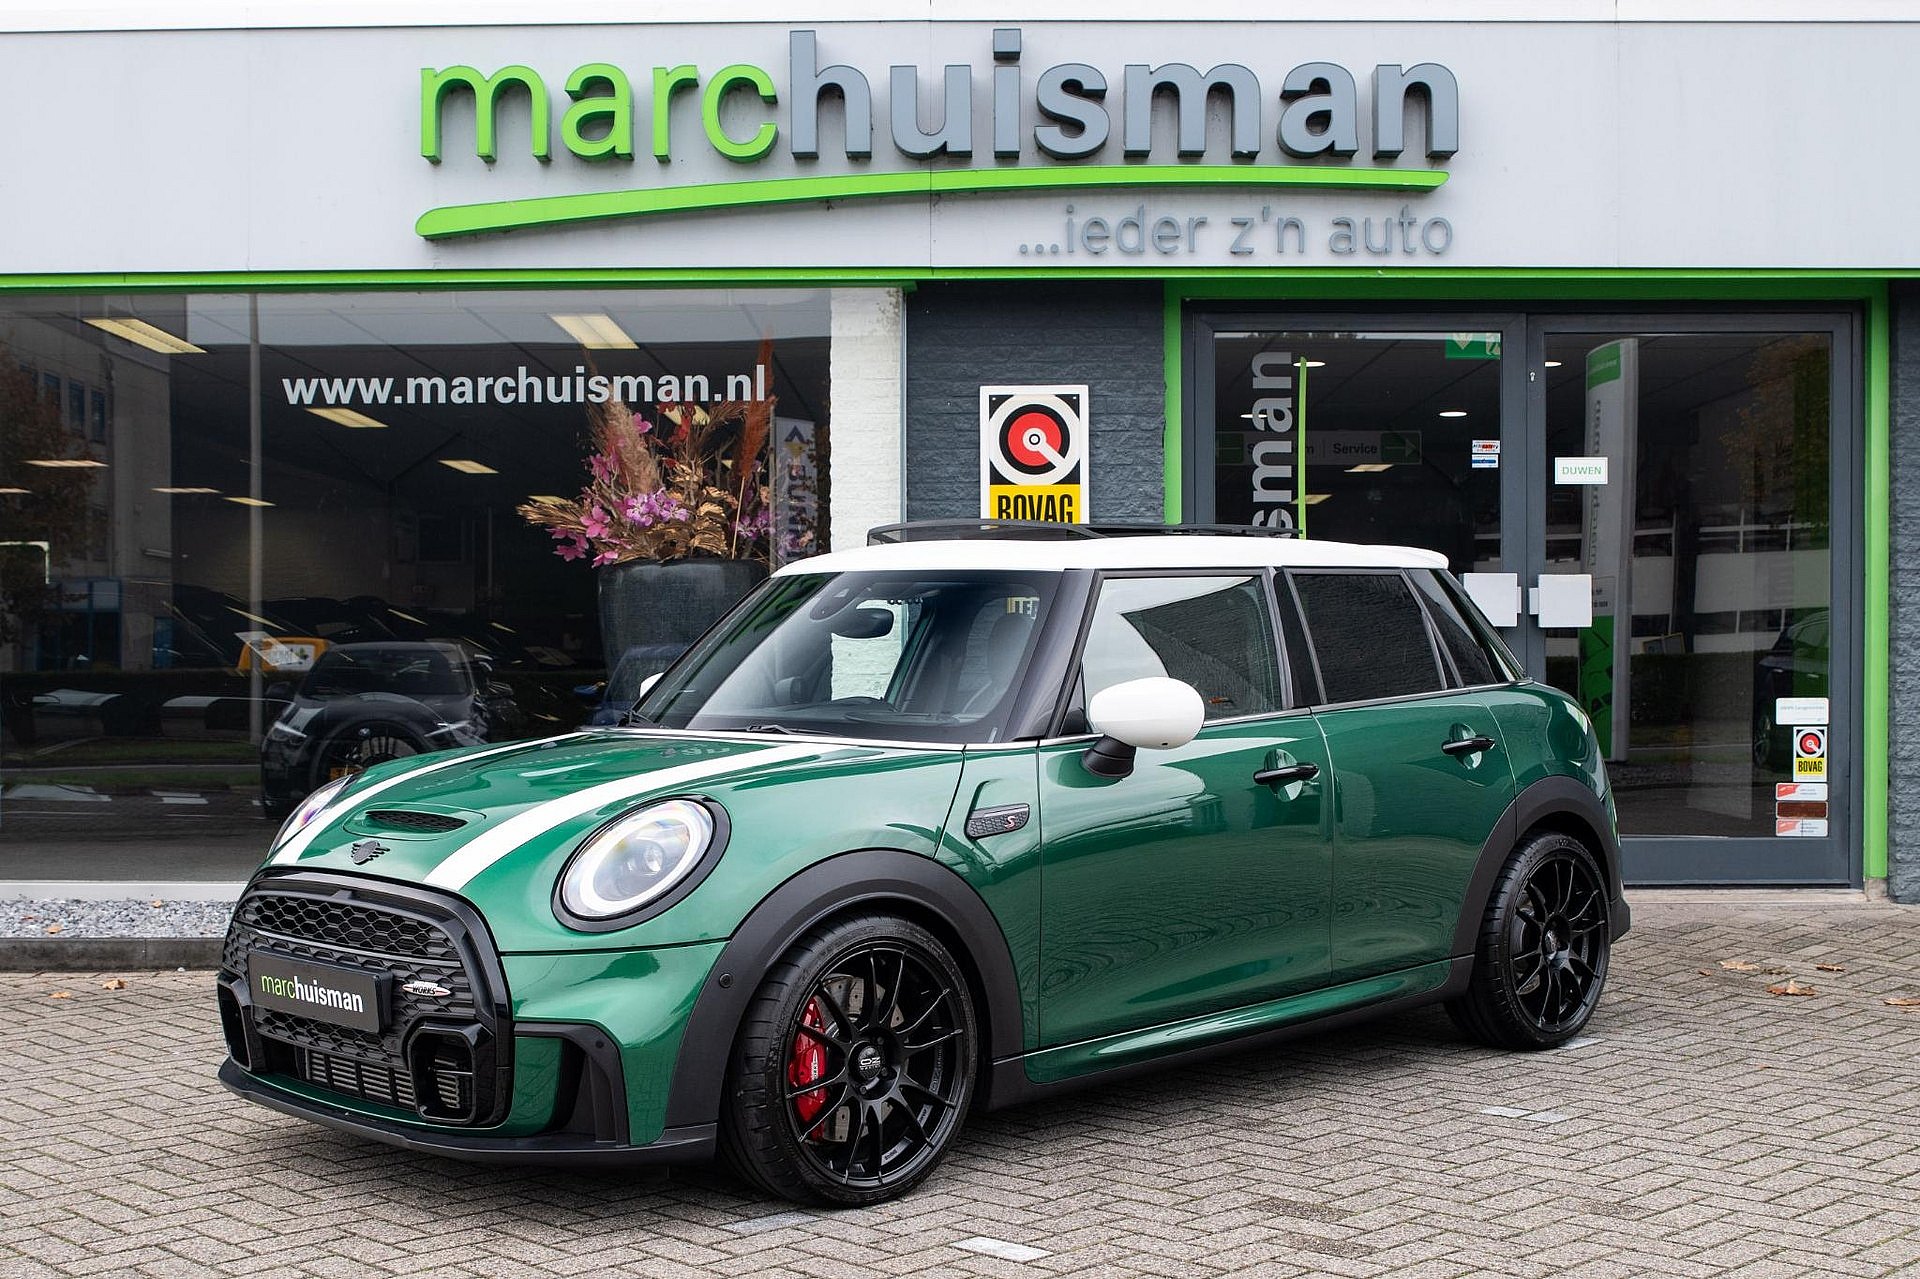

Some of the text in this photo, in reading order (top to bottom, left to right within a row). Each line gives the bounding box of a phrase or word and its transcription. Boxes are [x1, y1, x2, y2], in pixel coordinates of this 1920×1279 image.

[420, 29, 1459, 164] marchuisman
[1229, 205, 1306, 255] z'n
[1329, 206, 1454, 255] auto
[282, 364, 767, 405] www.marchuisman.nl
[1332, 442, 1378, 455] Service
[1562, 466, 1602, 475] DUWEN
[998, 494, 1073, 523] BOVAG
[1798, 760, 1823, 772] BOVAG
[1005, 816, 1016, 828] S
[260, 974, 364, 1013] marchuisman
